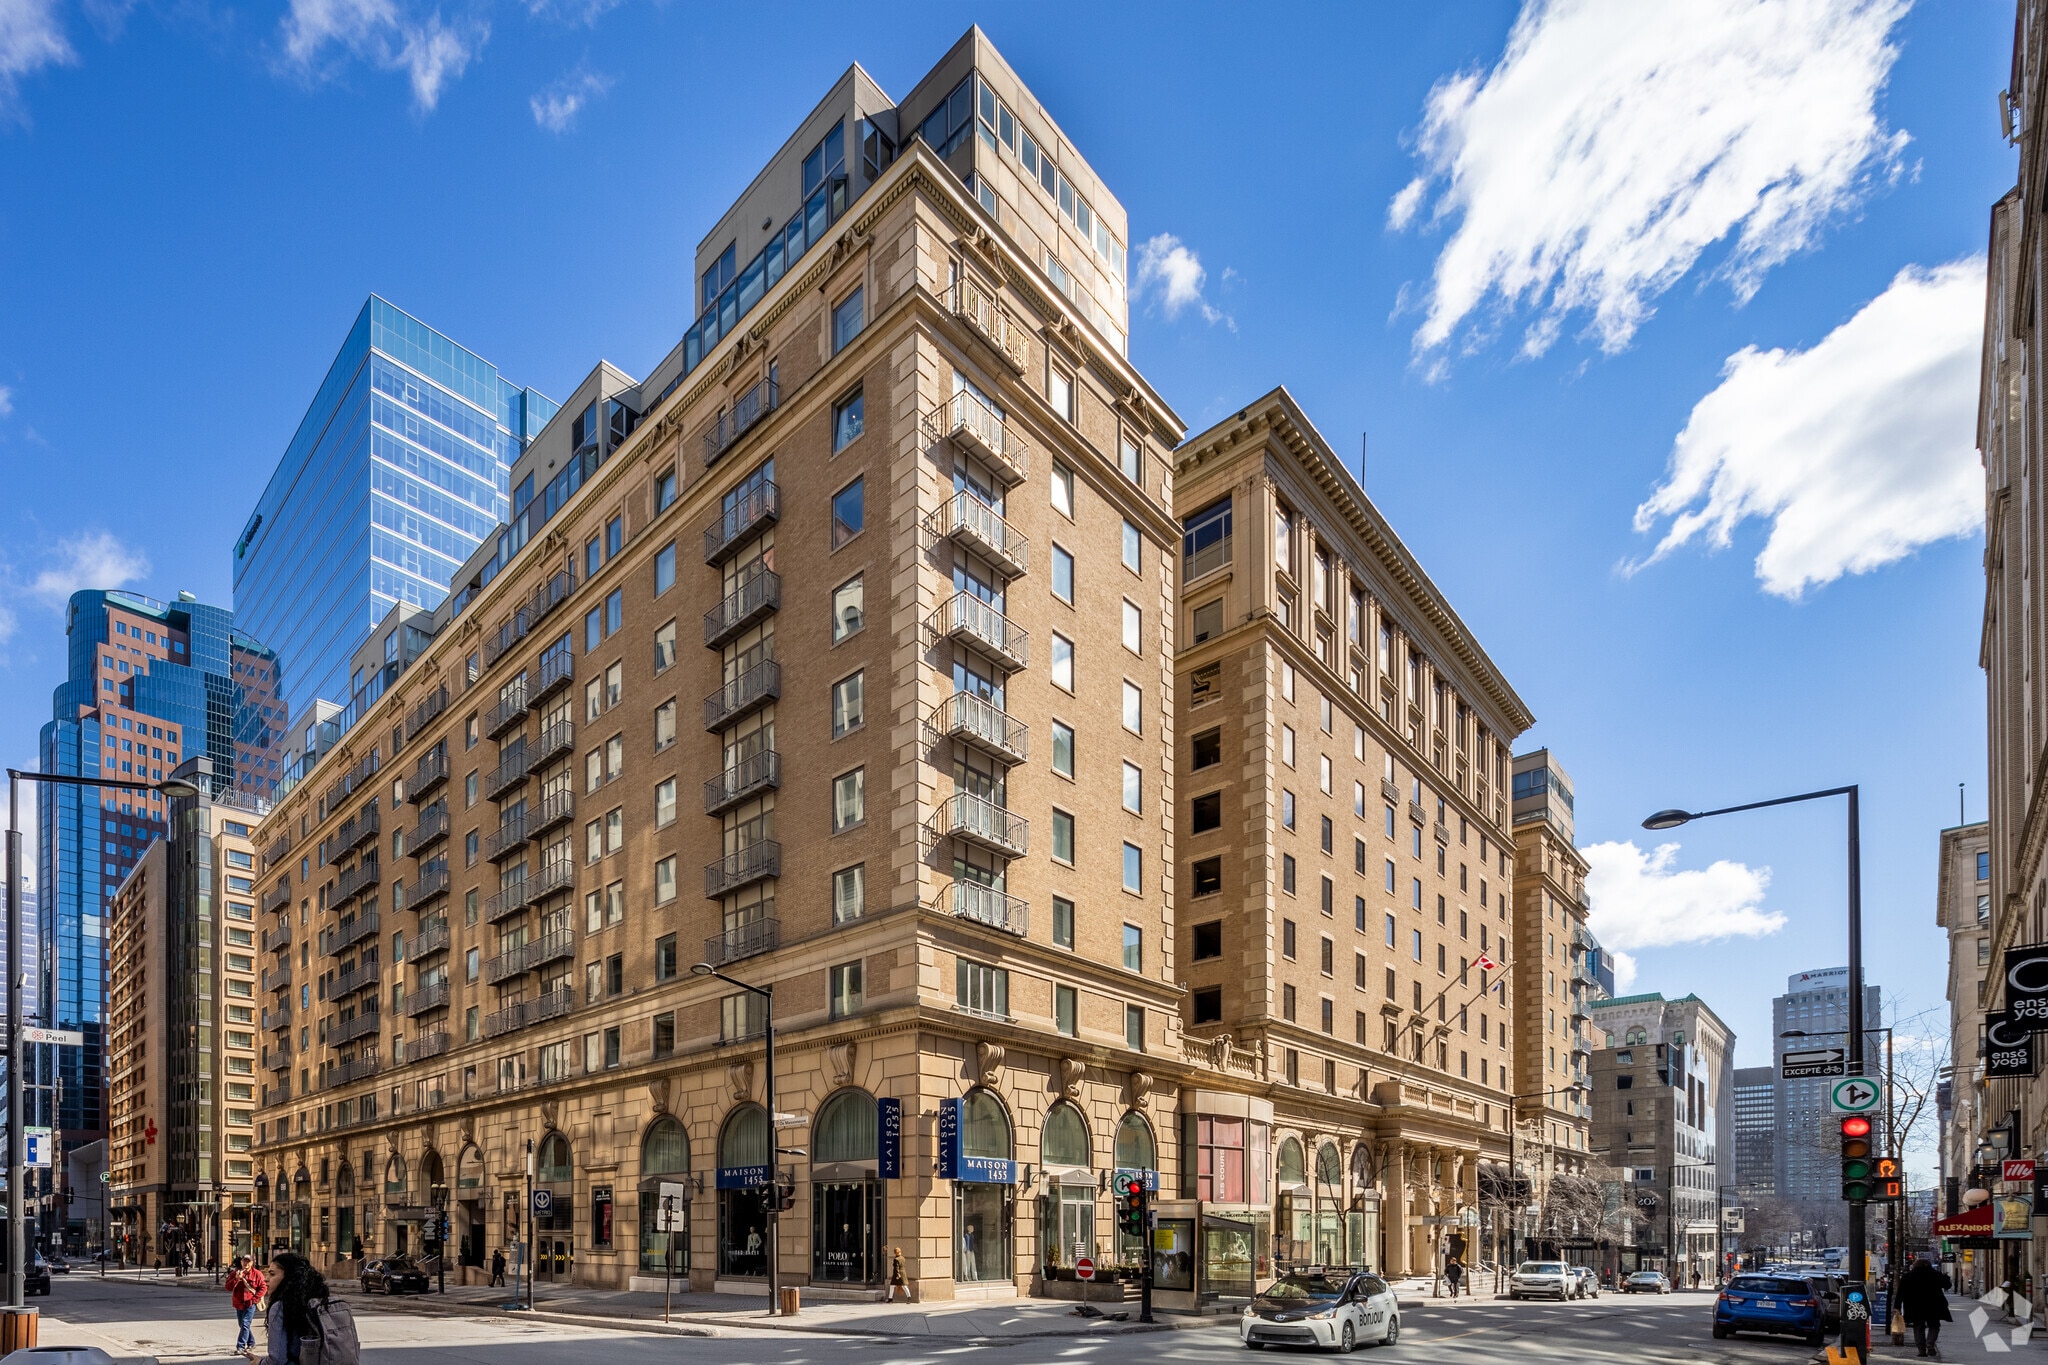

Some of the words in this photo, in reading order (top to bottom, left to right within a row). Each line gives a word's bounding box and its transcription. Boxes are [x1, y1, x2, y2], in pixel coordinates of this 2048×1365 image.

[1810, 970, 1849, 979] MARRIOT
[2013, 998, 2048, 1009] ens
[2014, 1006, 2048, 1021] yog
[45, 1033, 67, 1043] Peel
[1992, 1057, 2028, 1069] yoga
[1784, 1066, 1822, 1076] EXCEPTÉ
[948, 1106, 956, 1137] 1455
[940, 1106, 948, 1172] MAISON
[967, 1159, 1008, 1170] MAISON
[724, 1167, 764, 1177] MAISON
[988, 1170, 1008, 1181] 1455
[2005, 1163, 2034, 1179] illy
[744, 1175, 764, 1185] 1455
[1887, 1182, 1899, 1196] 0
[828, 1251, 848, 1261] POLO
